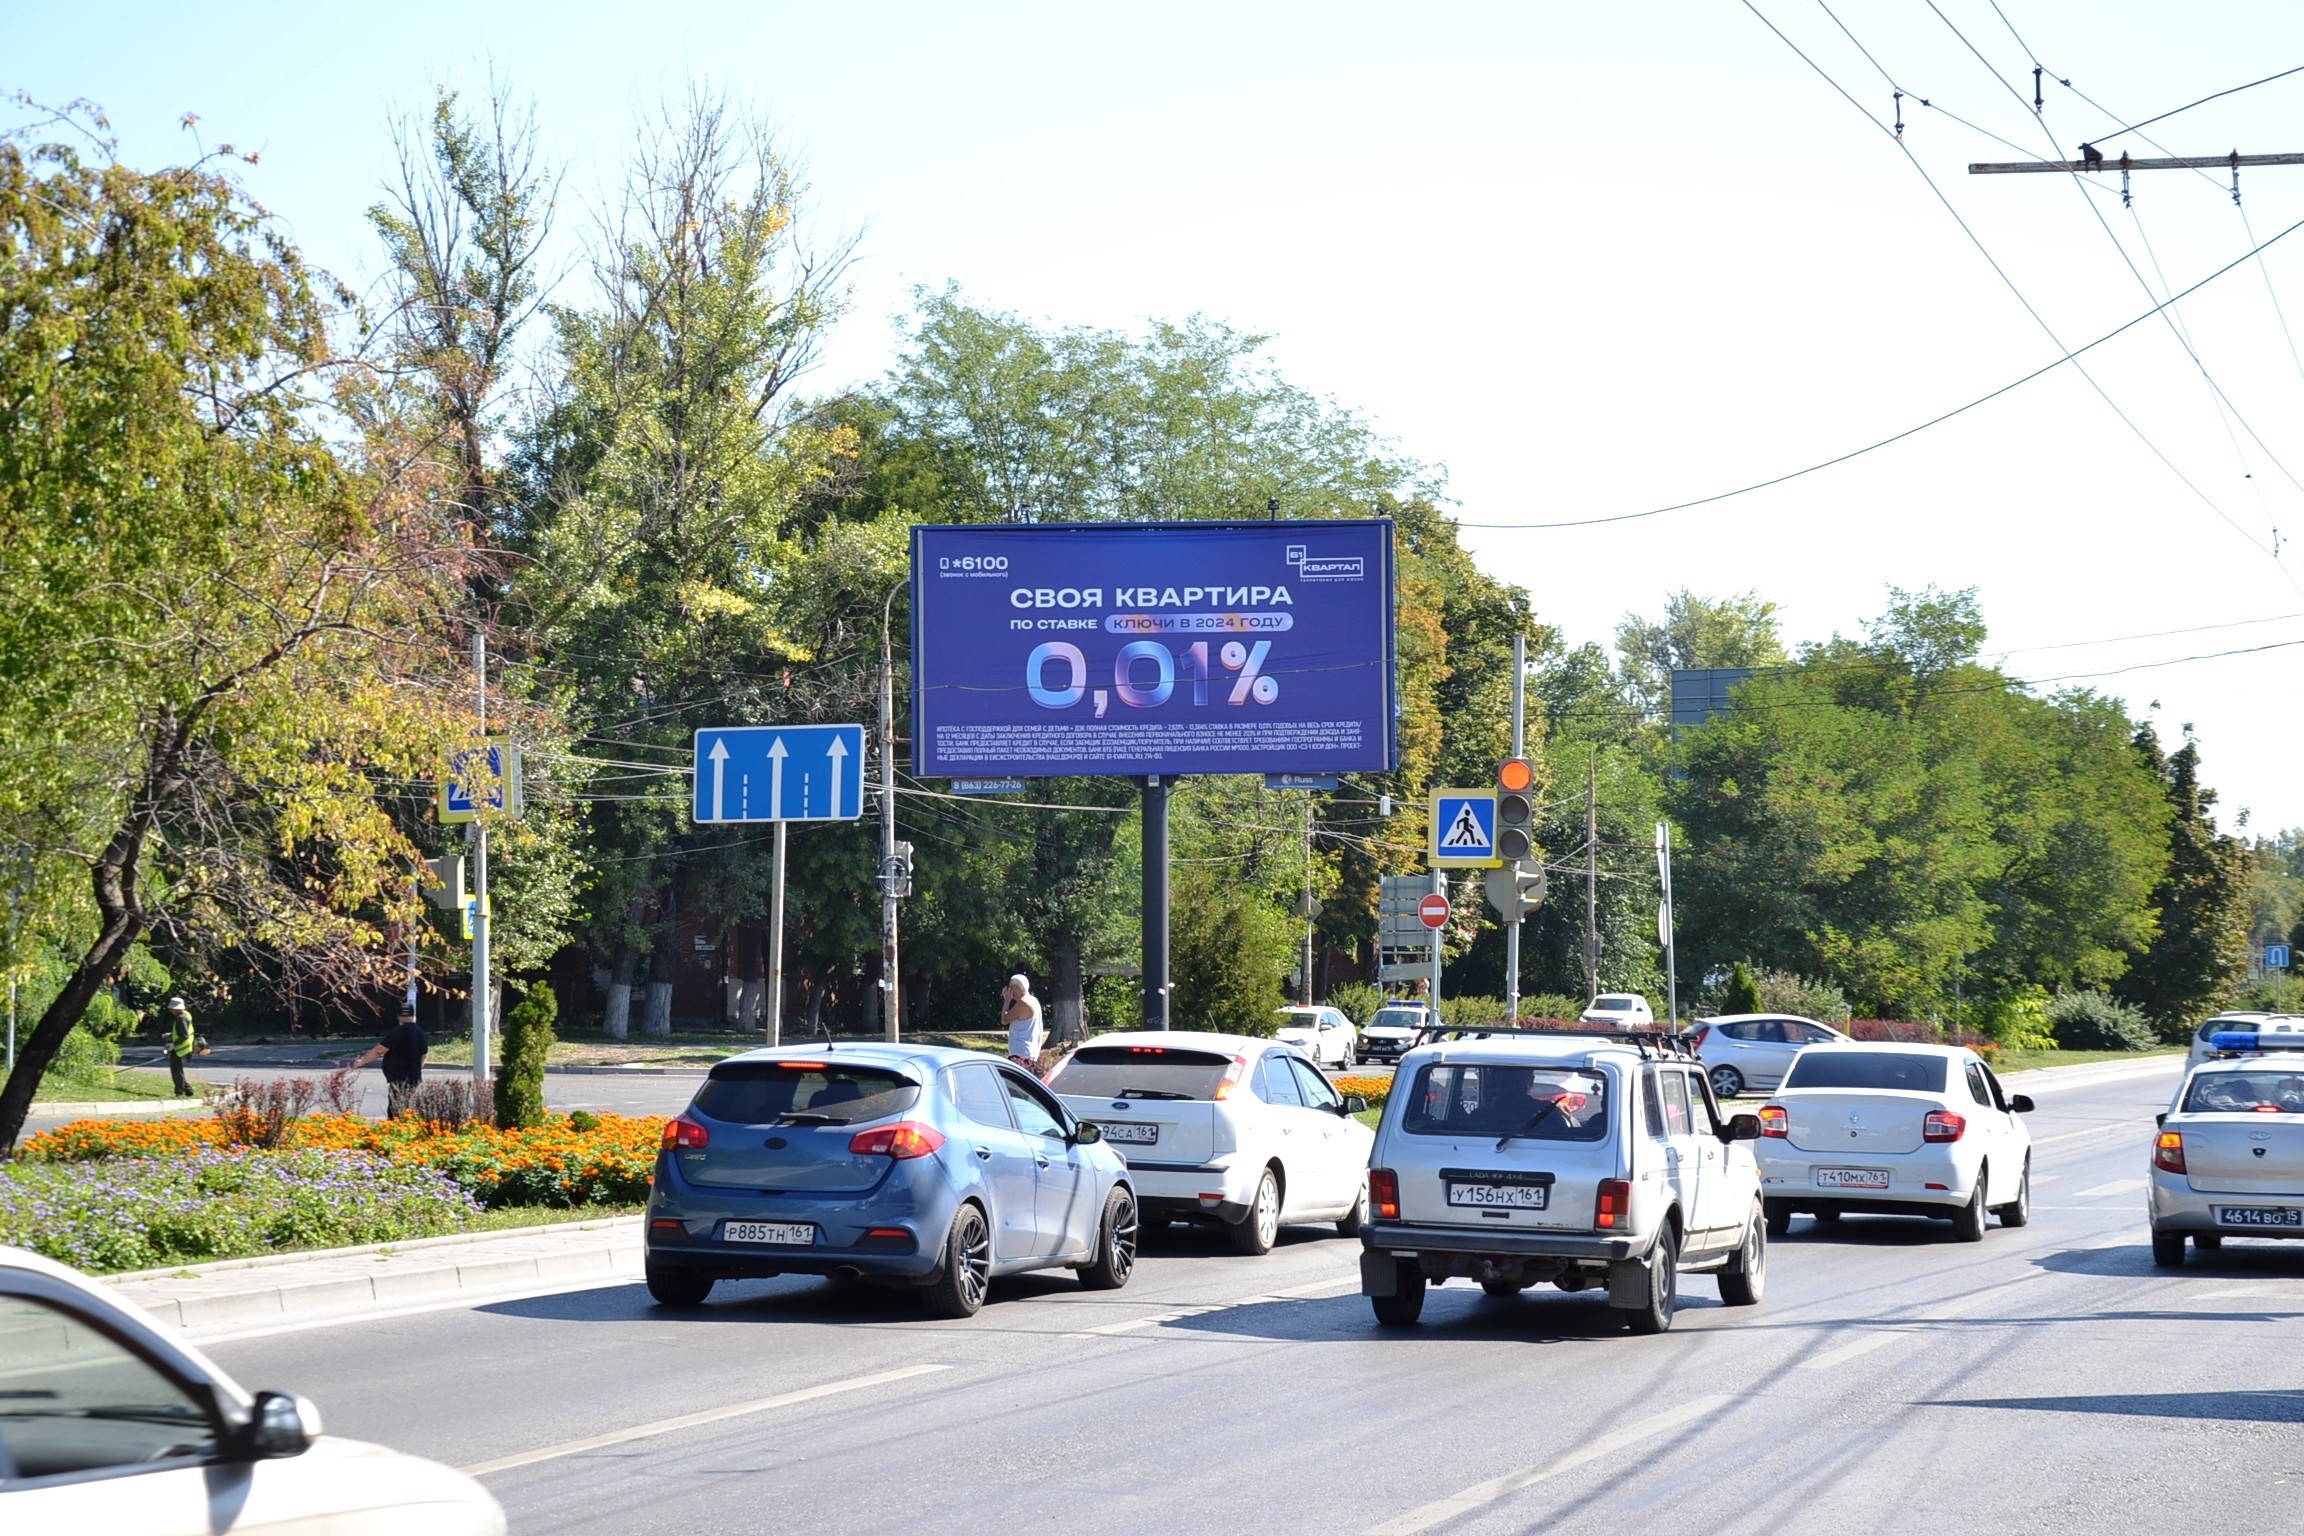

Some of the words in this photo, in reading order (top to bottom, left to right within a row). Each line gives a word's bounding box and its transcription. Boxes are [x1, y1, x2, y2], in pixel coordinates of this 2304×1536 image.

[1304, 564, 1360, 572] КВАРТАЛ
[1010, 588, 1102, 608] СВОЯ
[1116, 586, 1294, 608] КВАРТИРА
[1010, 620, 1034, 630] ПО
[1036, 619, 1098, 630] СТАВКЕ
[1113, 618, 1174, 630] КЛЮЧИ
[1180, 618, 1190, 628] В
[1196, 618, 1235, 628] 2024
[1240, 617, 1284, 628] ГОДУ
[1026, 640, 1279, 718] 0,01%
[954, 782, 960, 790] 8
[961, 781, 982, 790] (863)
[984, 780, 1022, 789] 226-77-26
[1136, 1127, 1154, 1136] 161
[1822, 1172, 1865, 1182] Т410МХ
[1867, 1172, 1886, 1180] 761
[1456, 1186, 1514, 1204] У156НХ
[1518, 1188, 1541, 1200] 161
[2225, 1210, 2260, 1222] 4614
[728, 1224, 786, 1242] Р885ТН
[789, 1226, 811, 1238] 161
